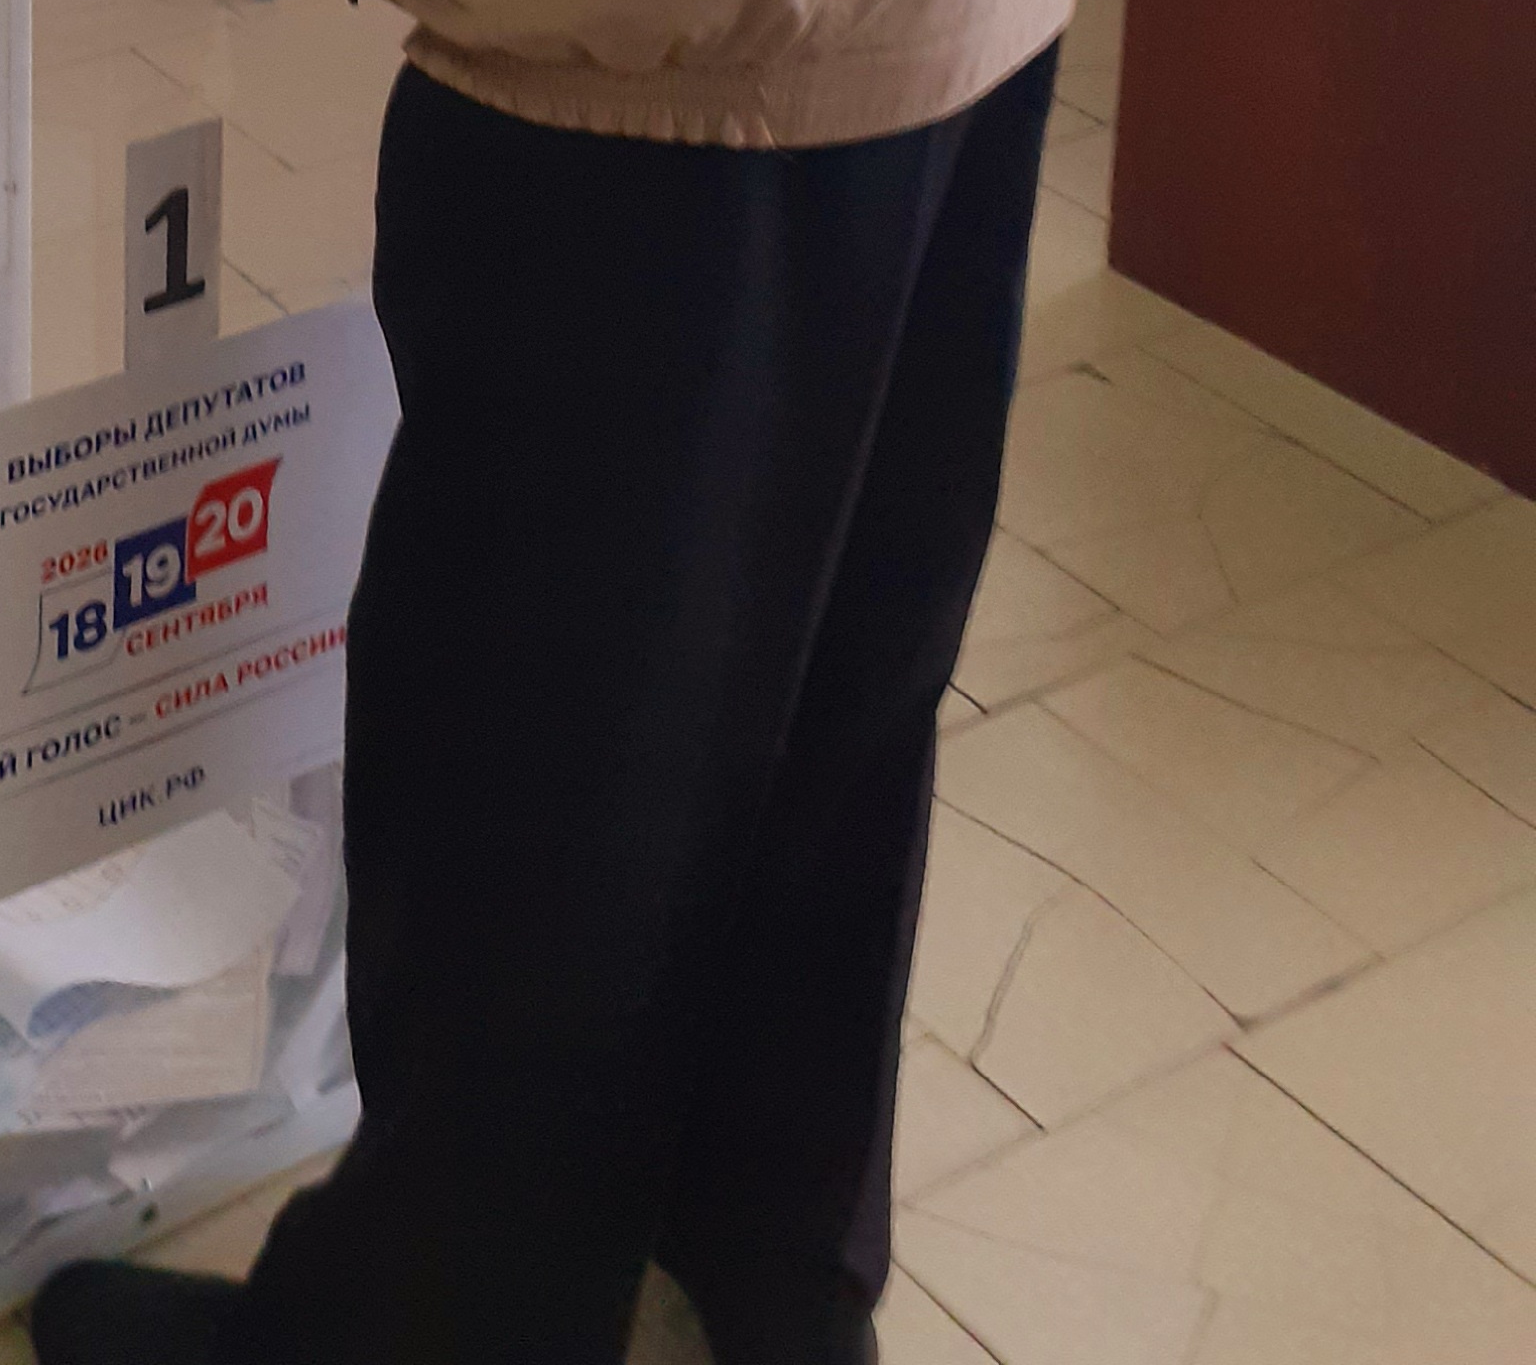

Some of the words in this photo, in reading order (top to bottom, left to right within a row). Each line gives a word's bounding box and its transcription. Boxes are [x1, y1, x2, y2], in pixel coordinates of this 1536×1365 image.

[143, 187, 205, 313] 1
[0, 426, 236, 529] ГОСУДАРСТВЕННОЙ
[242, 402, 310, 445] ДУМЫ
[7, 420, 137, 484] ВЫБОРЫ
[144, 362, 306, 441] ДЕПУТАТОВ
[41, 538, 109, 584] 2026
[48, 600, 107, 660] 18
[122, 543, 182, 607] 19
[194, 488, 264, 557] 20
[125, 583, 268, 657] СЕНТЯБРЯ
[25, 715, 121, 769] ГОЛОС
[154, 673, 229, 720] СИЛА
